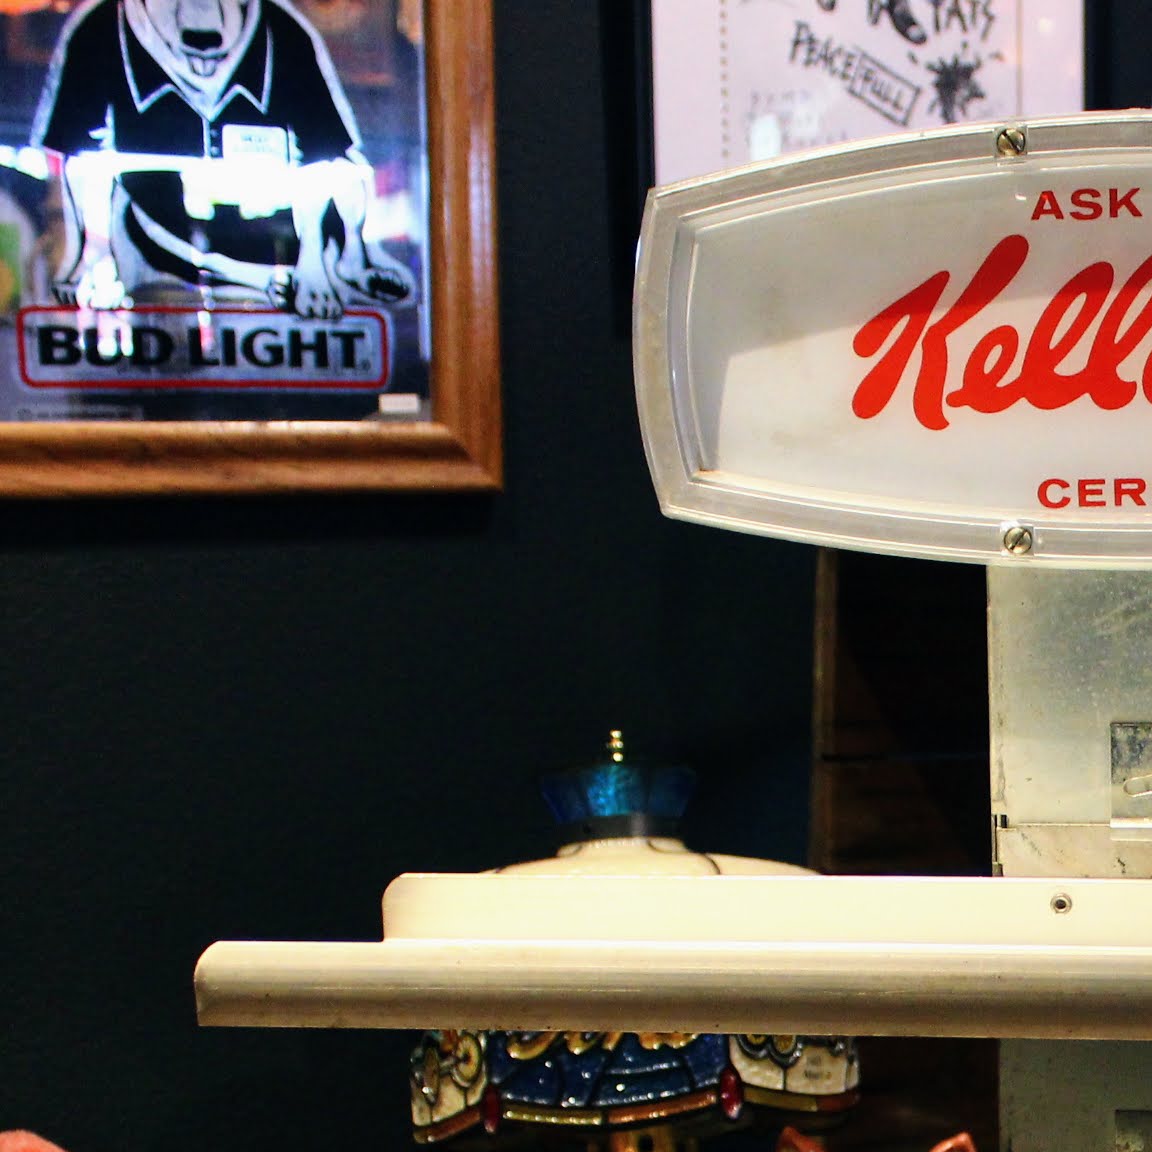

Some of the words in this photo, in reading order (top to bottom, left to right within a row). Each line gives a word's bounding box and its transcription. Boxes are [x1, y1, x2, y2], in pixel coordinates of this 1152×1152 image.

[789, 20, 857, 81] PEACE
[1031, 188, 1142, 221] ASK
[37, 326, 174, 366] BUD
[187, 328, 366, 368] LIGHT
